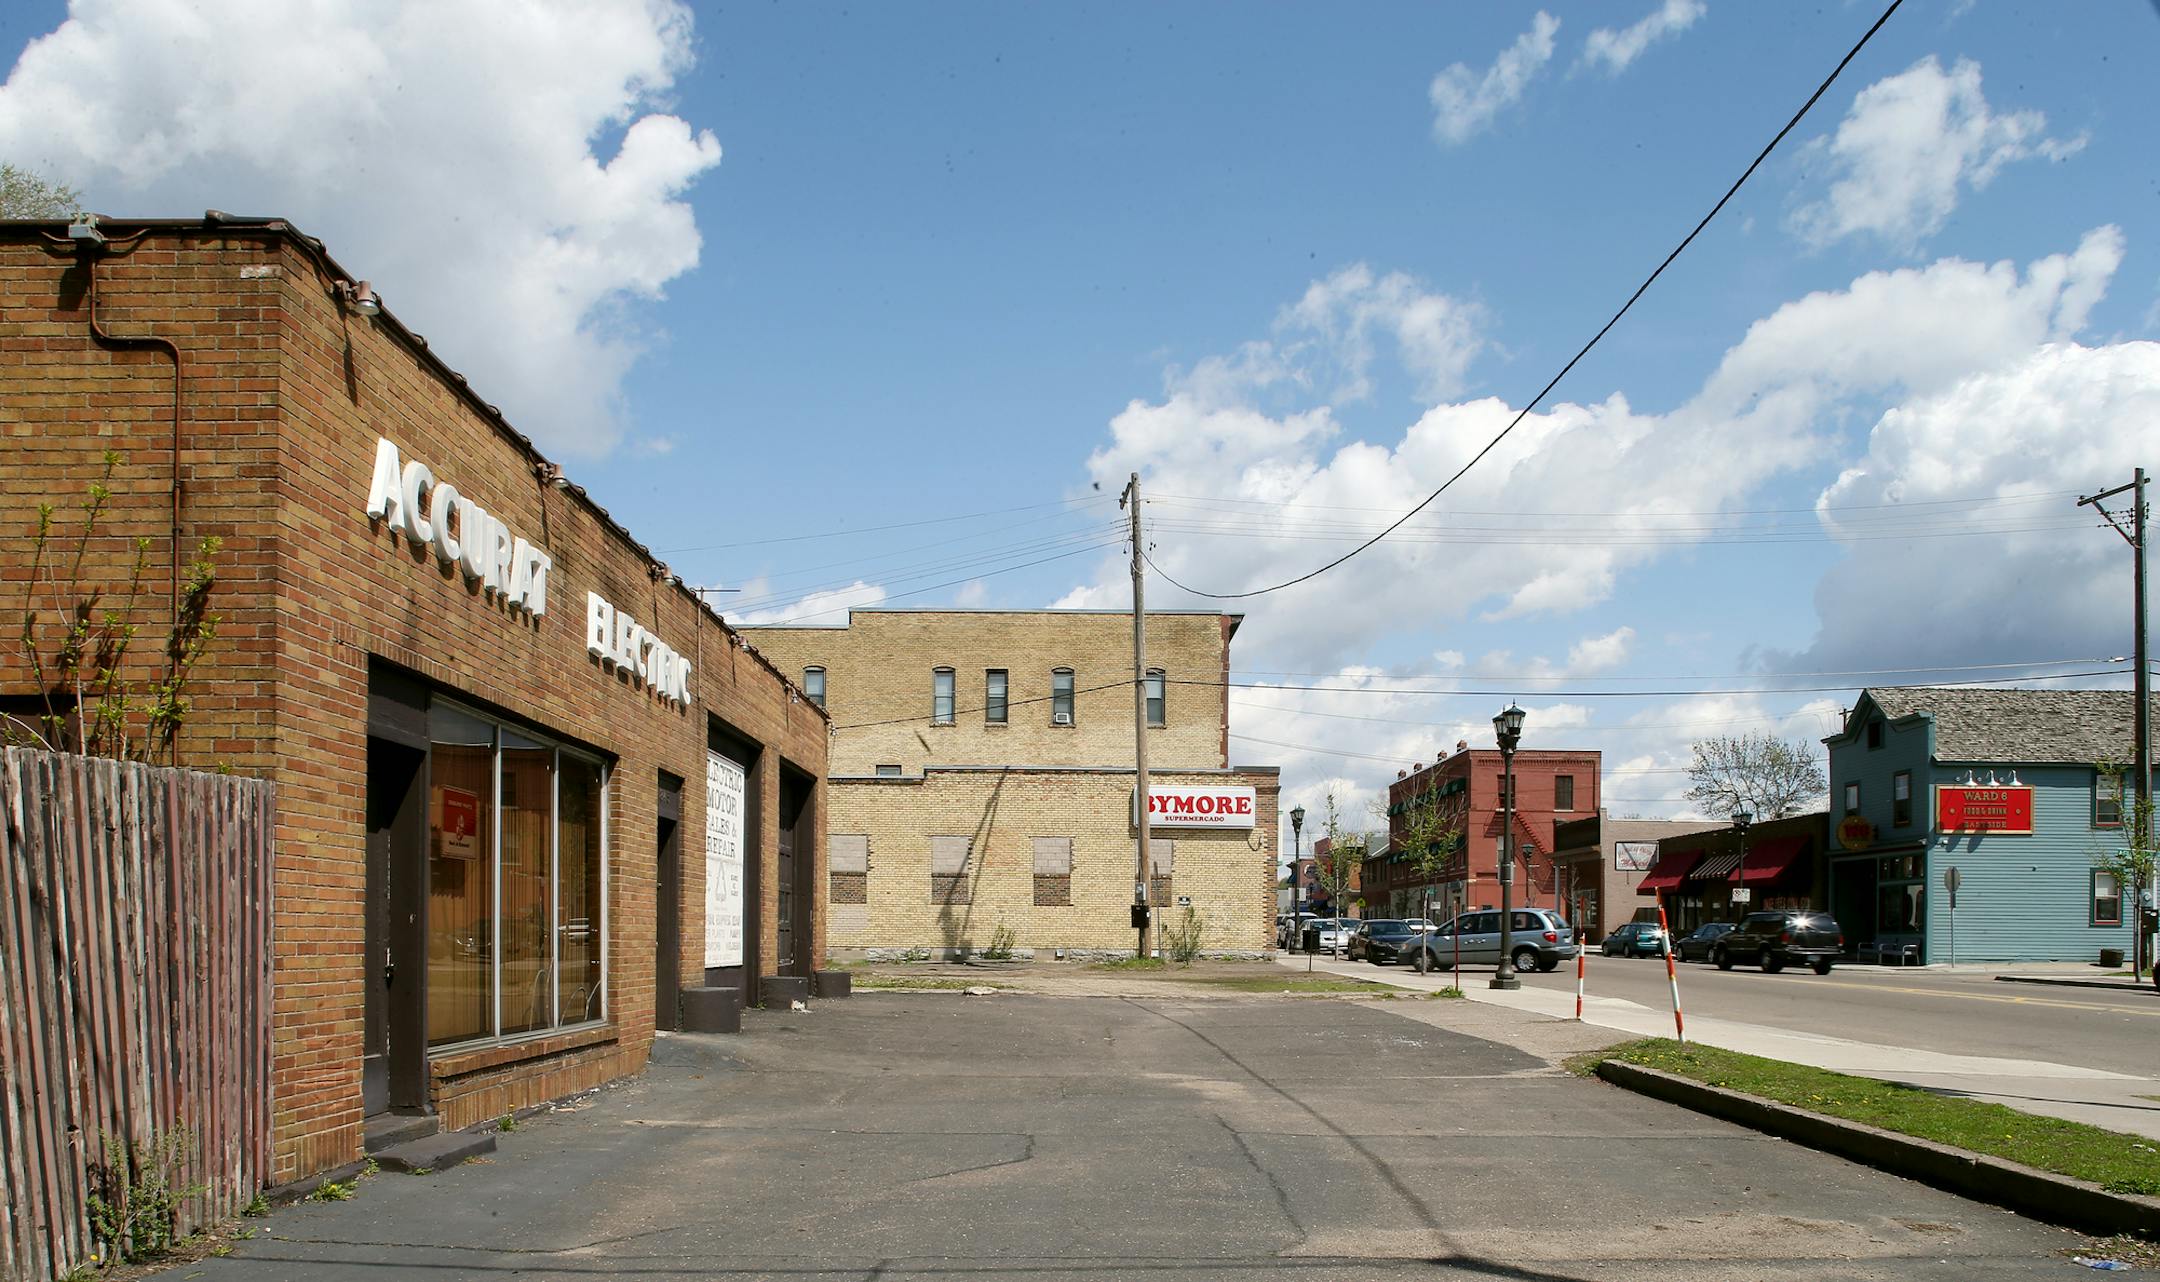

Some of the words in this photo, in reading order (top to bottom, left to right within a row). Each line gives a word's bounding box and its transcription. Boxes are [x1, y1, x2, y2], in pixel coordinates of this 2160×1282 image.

[366, 437, 552, 617] ACCURAT
[587, 590, 692, 706] ELECTRIC
[706, 786, 737, 817] MOTOR
[1964, 791, 1998, 800] WARD
[706, 835, 736, 859] REPAIR
